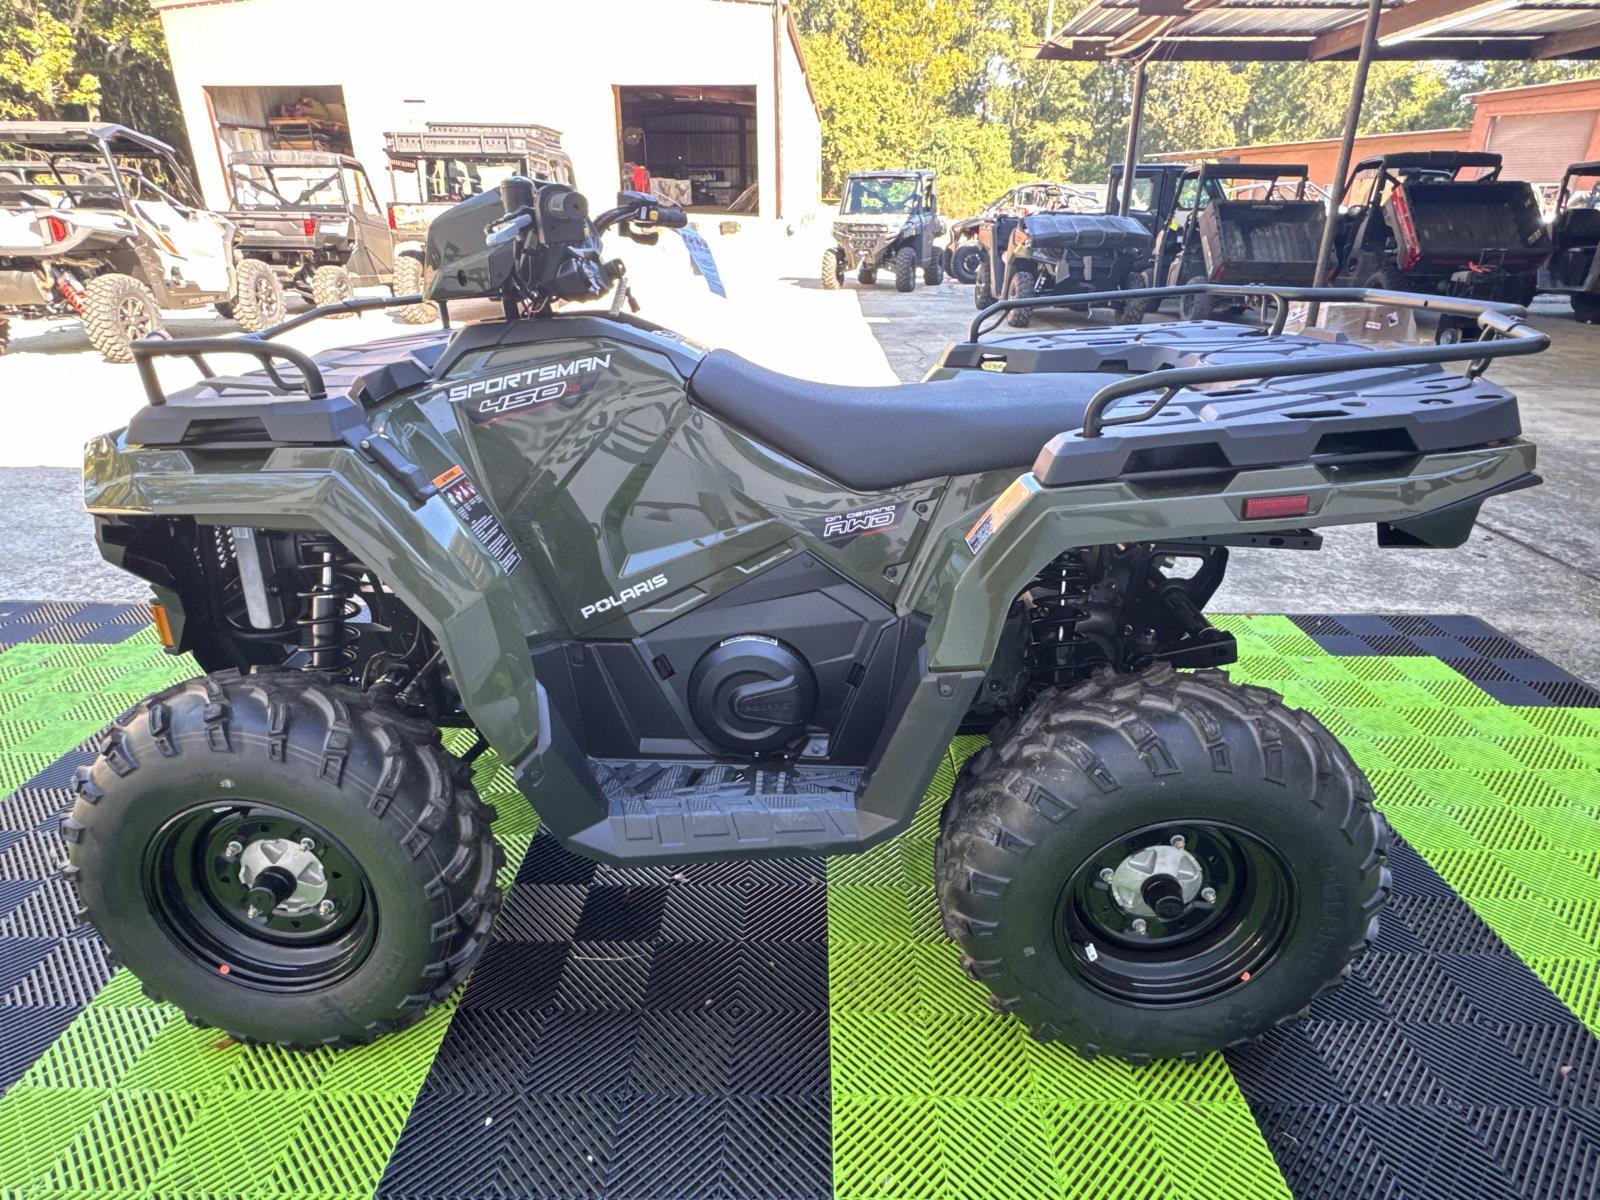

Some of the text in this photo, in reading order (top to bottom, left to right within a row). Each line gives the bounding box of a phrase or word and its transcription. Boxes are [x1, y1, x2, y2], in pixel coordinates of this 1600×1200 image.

[448, 354, 612, 402] SPORTSMAN
[479, 381, 567, 413] 450
[823, 511, 896, 537] AWD
[825, 505, 896, 523] ON DEMAND
[580, 573, 669, 619] POLARIS
